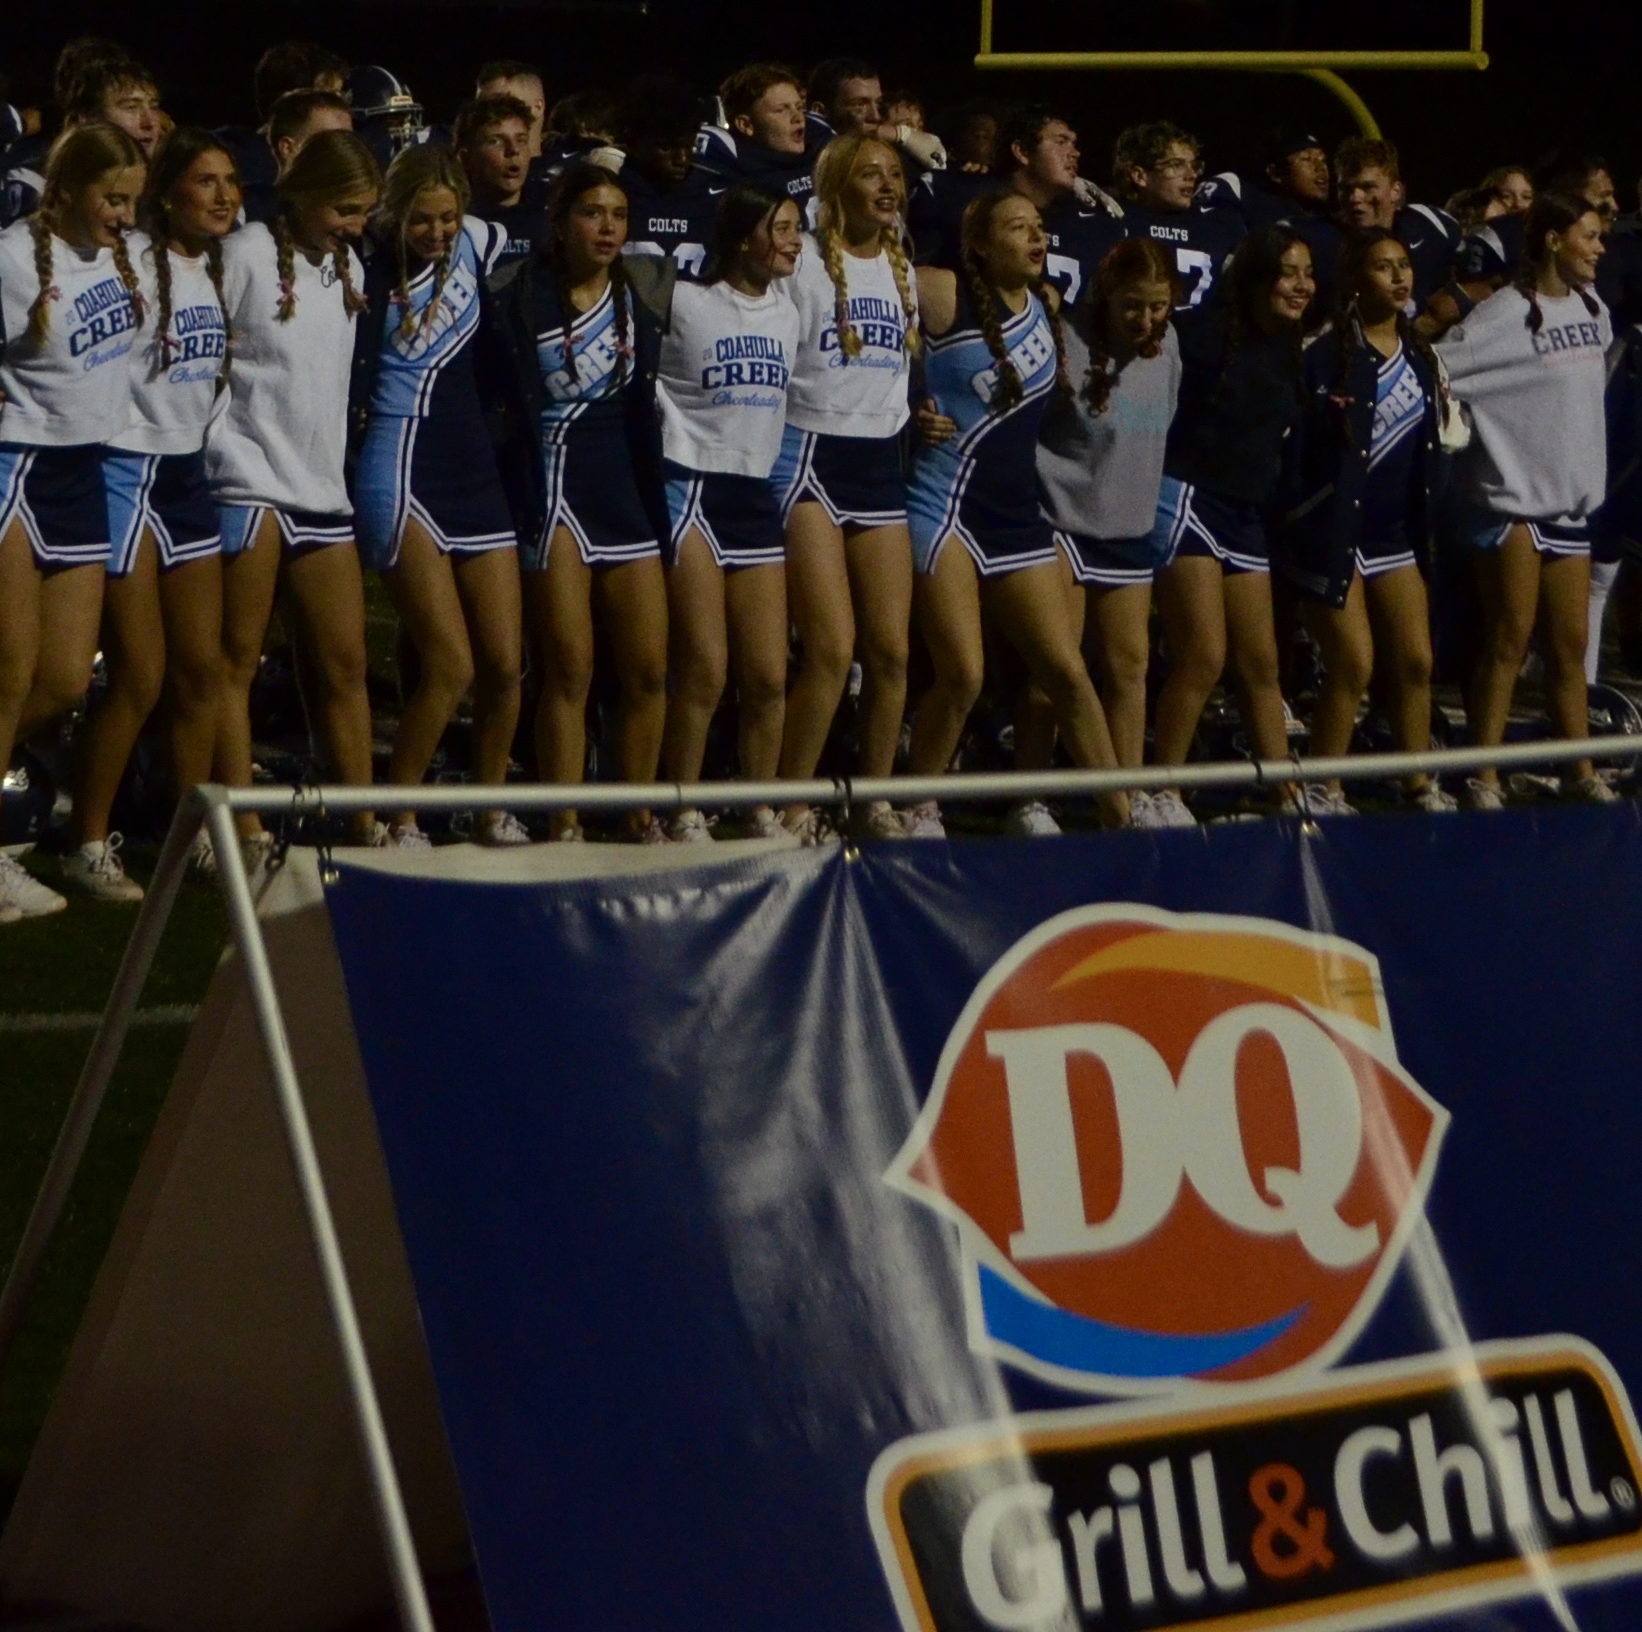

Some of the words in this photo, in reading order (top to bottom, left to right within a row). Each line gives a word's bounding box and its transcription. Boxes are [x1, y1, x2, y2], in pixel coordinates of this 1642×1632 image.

[648, 218, 688, 233] COLTS
[1150, 225, 1189, 241] COLTS
[716, 335, 786, 365] COAHULLA
[1530, 322, 1602, 356] CREEK
[985, 1002, 1381, 1269] DQ
[961, 1448, 1247, 1631] Grill
[1248, 1460, 1336, 1582] &
[1333, 1385, 1610, 1564] Chill
